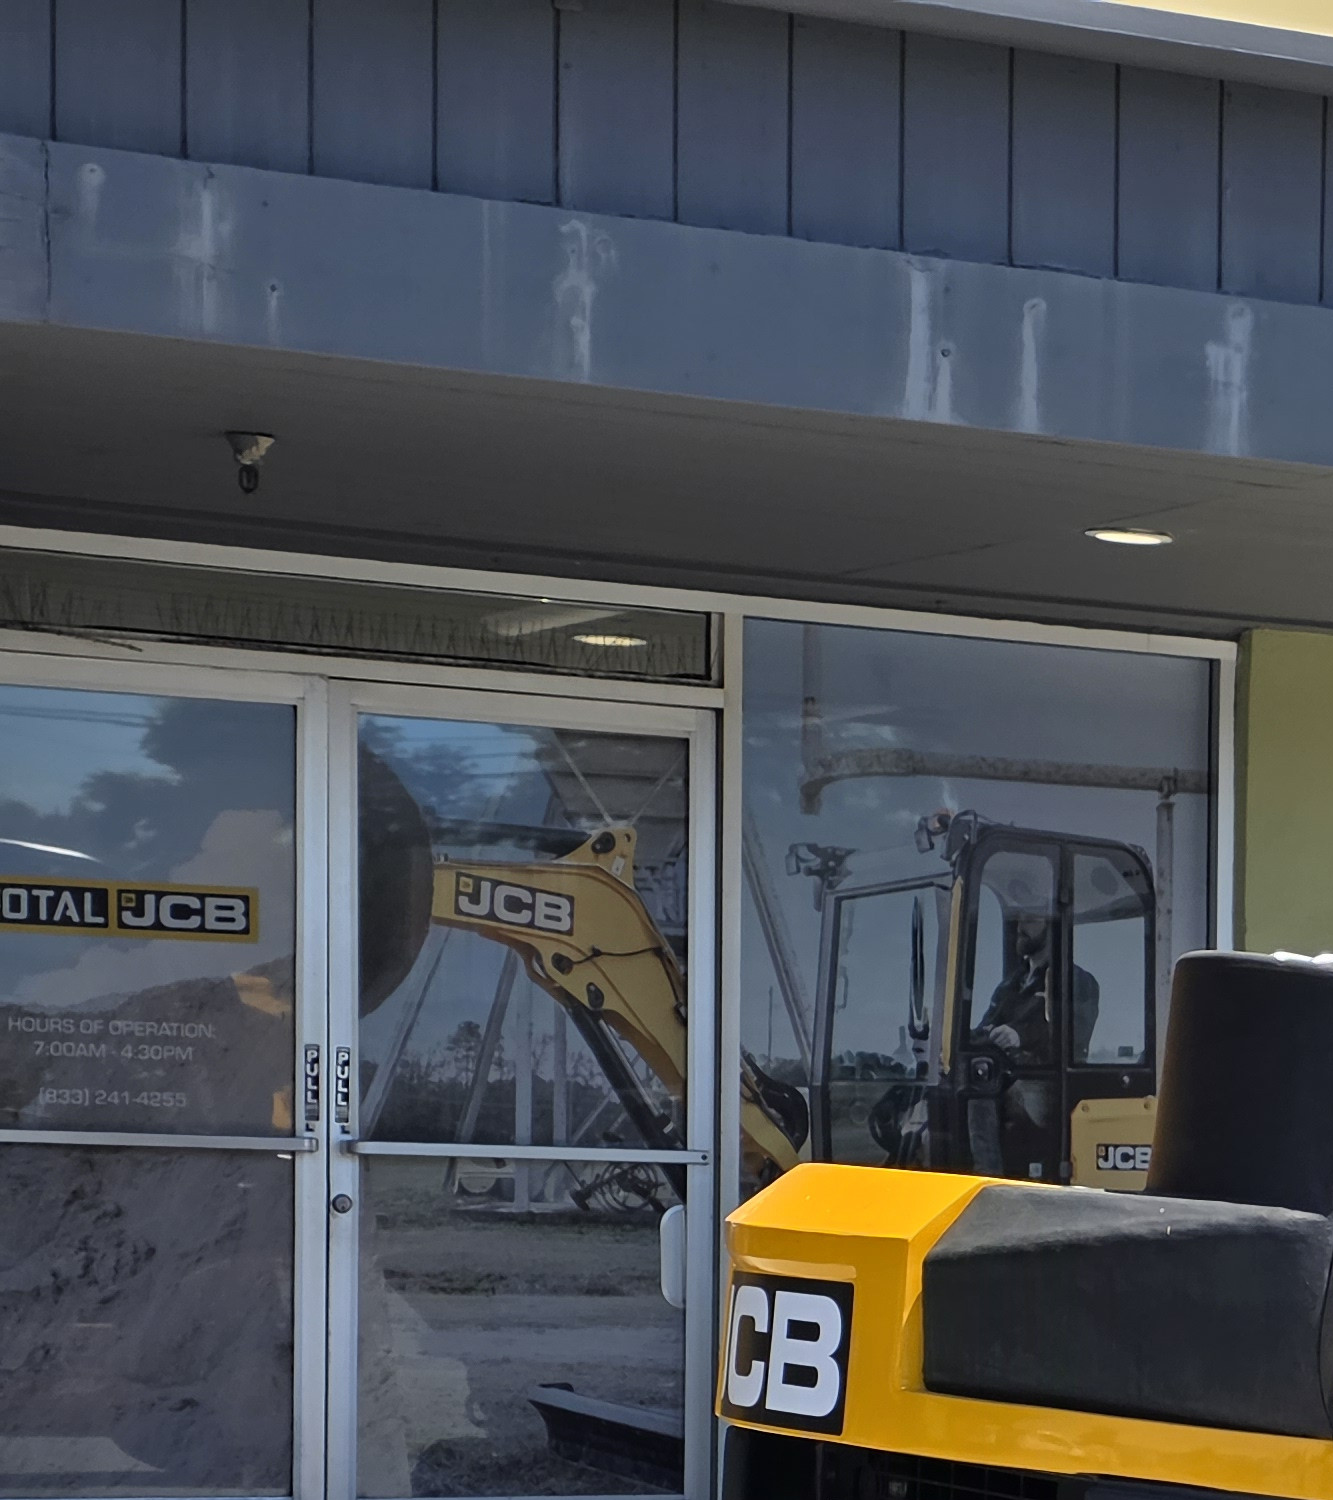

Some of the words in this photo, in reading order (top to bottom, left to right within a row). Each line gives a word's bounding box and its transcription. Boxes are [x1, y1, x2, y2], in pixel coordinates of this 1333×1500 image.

[0, 887, 105, 924] OTAL
[121, 894, 247, 931] JCB
[458, 880, 571, 931] JCB
[8, 1016, 75, 1034] HOURS
[80, 1019, 104, 1035] OF
[109, 1020, 216, 1038] OPERATION:
[34, 1041, 106, 1058] 7:00AM
[121, 1044, 193, 1061] 4:30PM
[39, 1087, 89, 1106] (833)
[95, 1089, 187, 1107] 241-4255
[306, 1049, 318, 1104] PULL
[336, 1051, 349, 1106] PULL
[1098, 1146, 1152, 1169] JCB
[721, 1284, 842, 1417] CB
